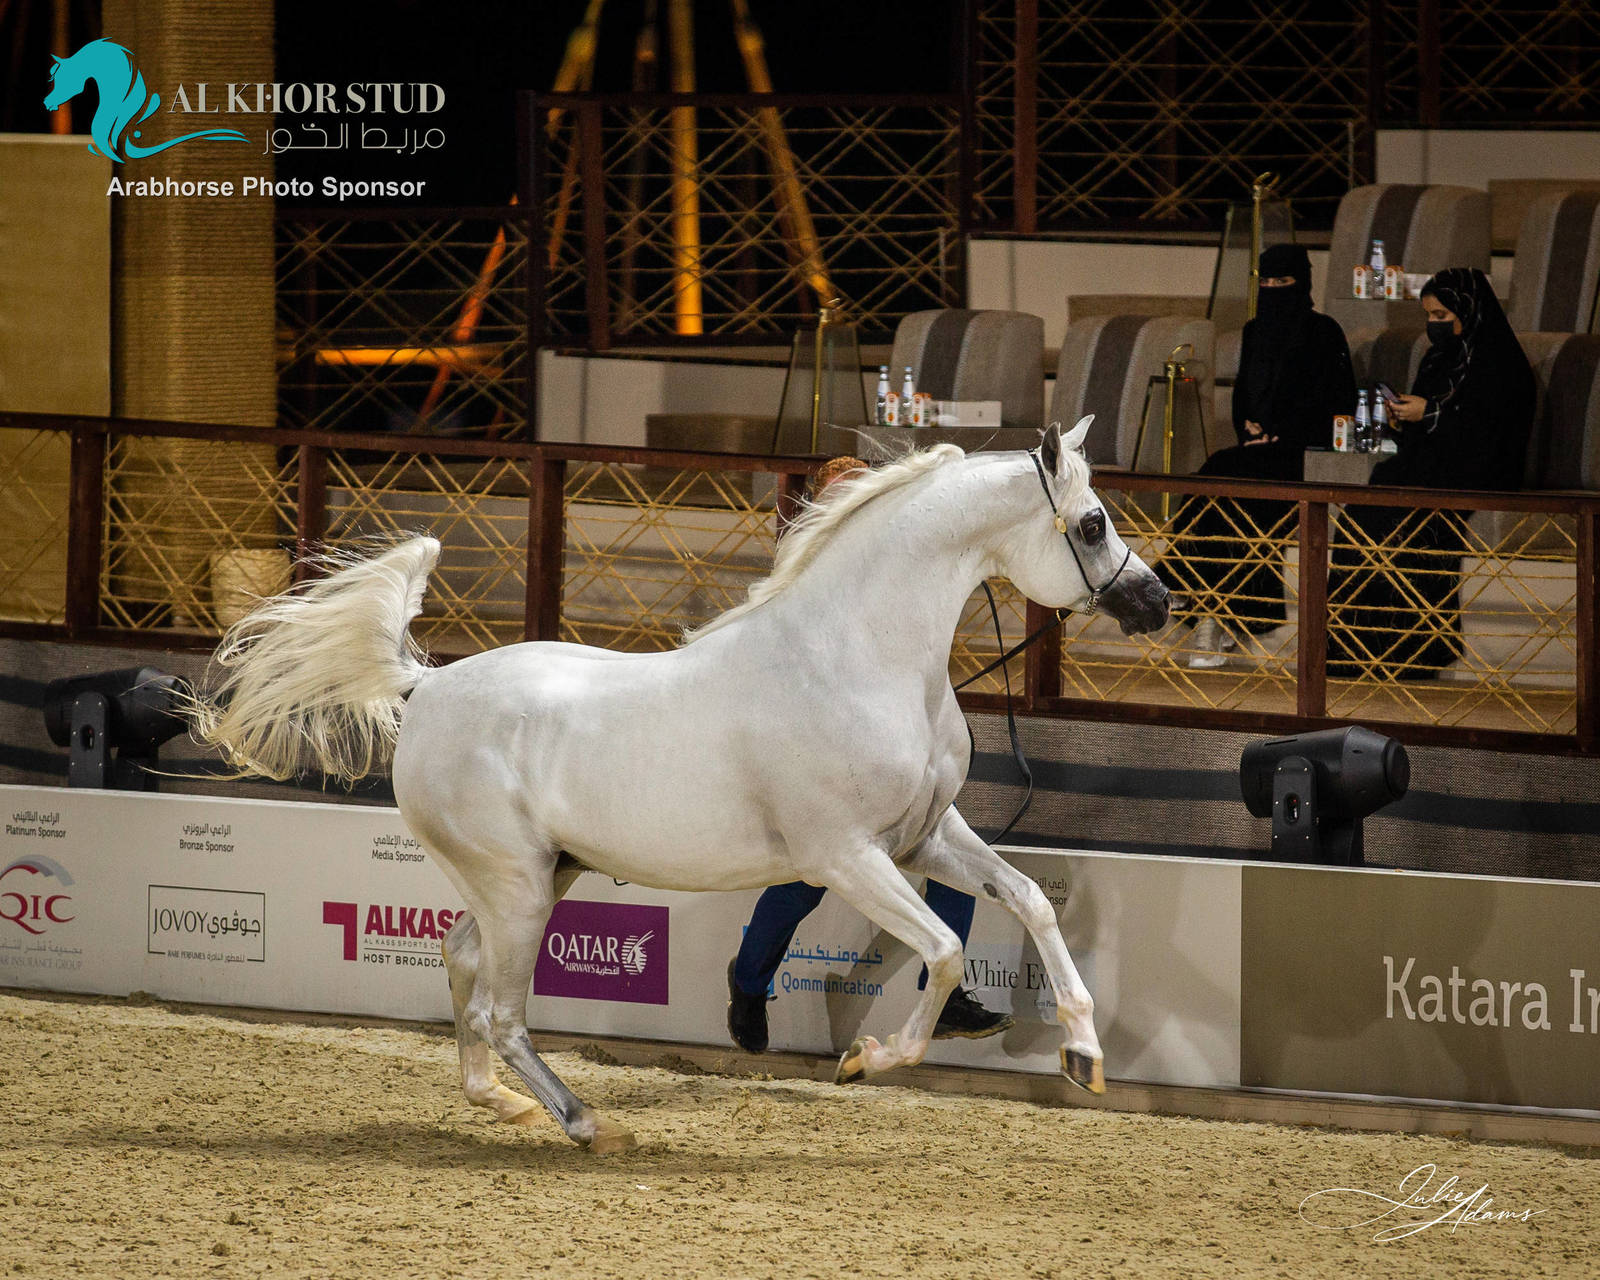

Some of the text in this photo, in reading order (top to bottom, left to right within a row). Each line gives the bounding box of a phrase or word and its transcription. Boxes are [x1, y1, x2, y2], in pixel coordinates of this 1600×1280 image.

[5, 825, 67, 839] Platinum Sponsor
[179, 838, 234, 854] Bronze Sponsor
[371, 848, 426, 864] Media Sponsor
[0, 891, 76, 935] QIC
[153, 908, 208, 935] JOVOY
[375, 938, 396, 947] KASS
[397, 940, 429, 950] SPORTS
[430, 942, 442, 950] CH
[547, 932, 620, 966] QATAR
[363, 953, 445, 968] HOST BROADCA
[564, 961, 596, 974] AIRWAYS
[781, 971, 883, 997] Qommunication
[963, 958, 1054, 990] White Ev
[1383, 955, 1551, 1031] Katara
